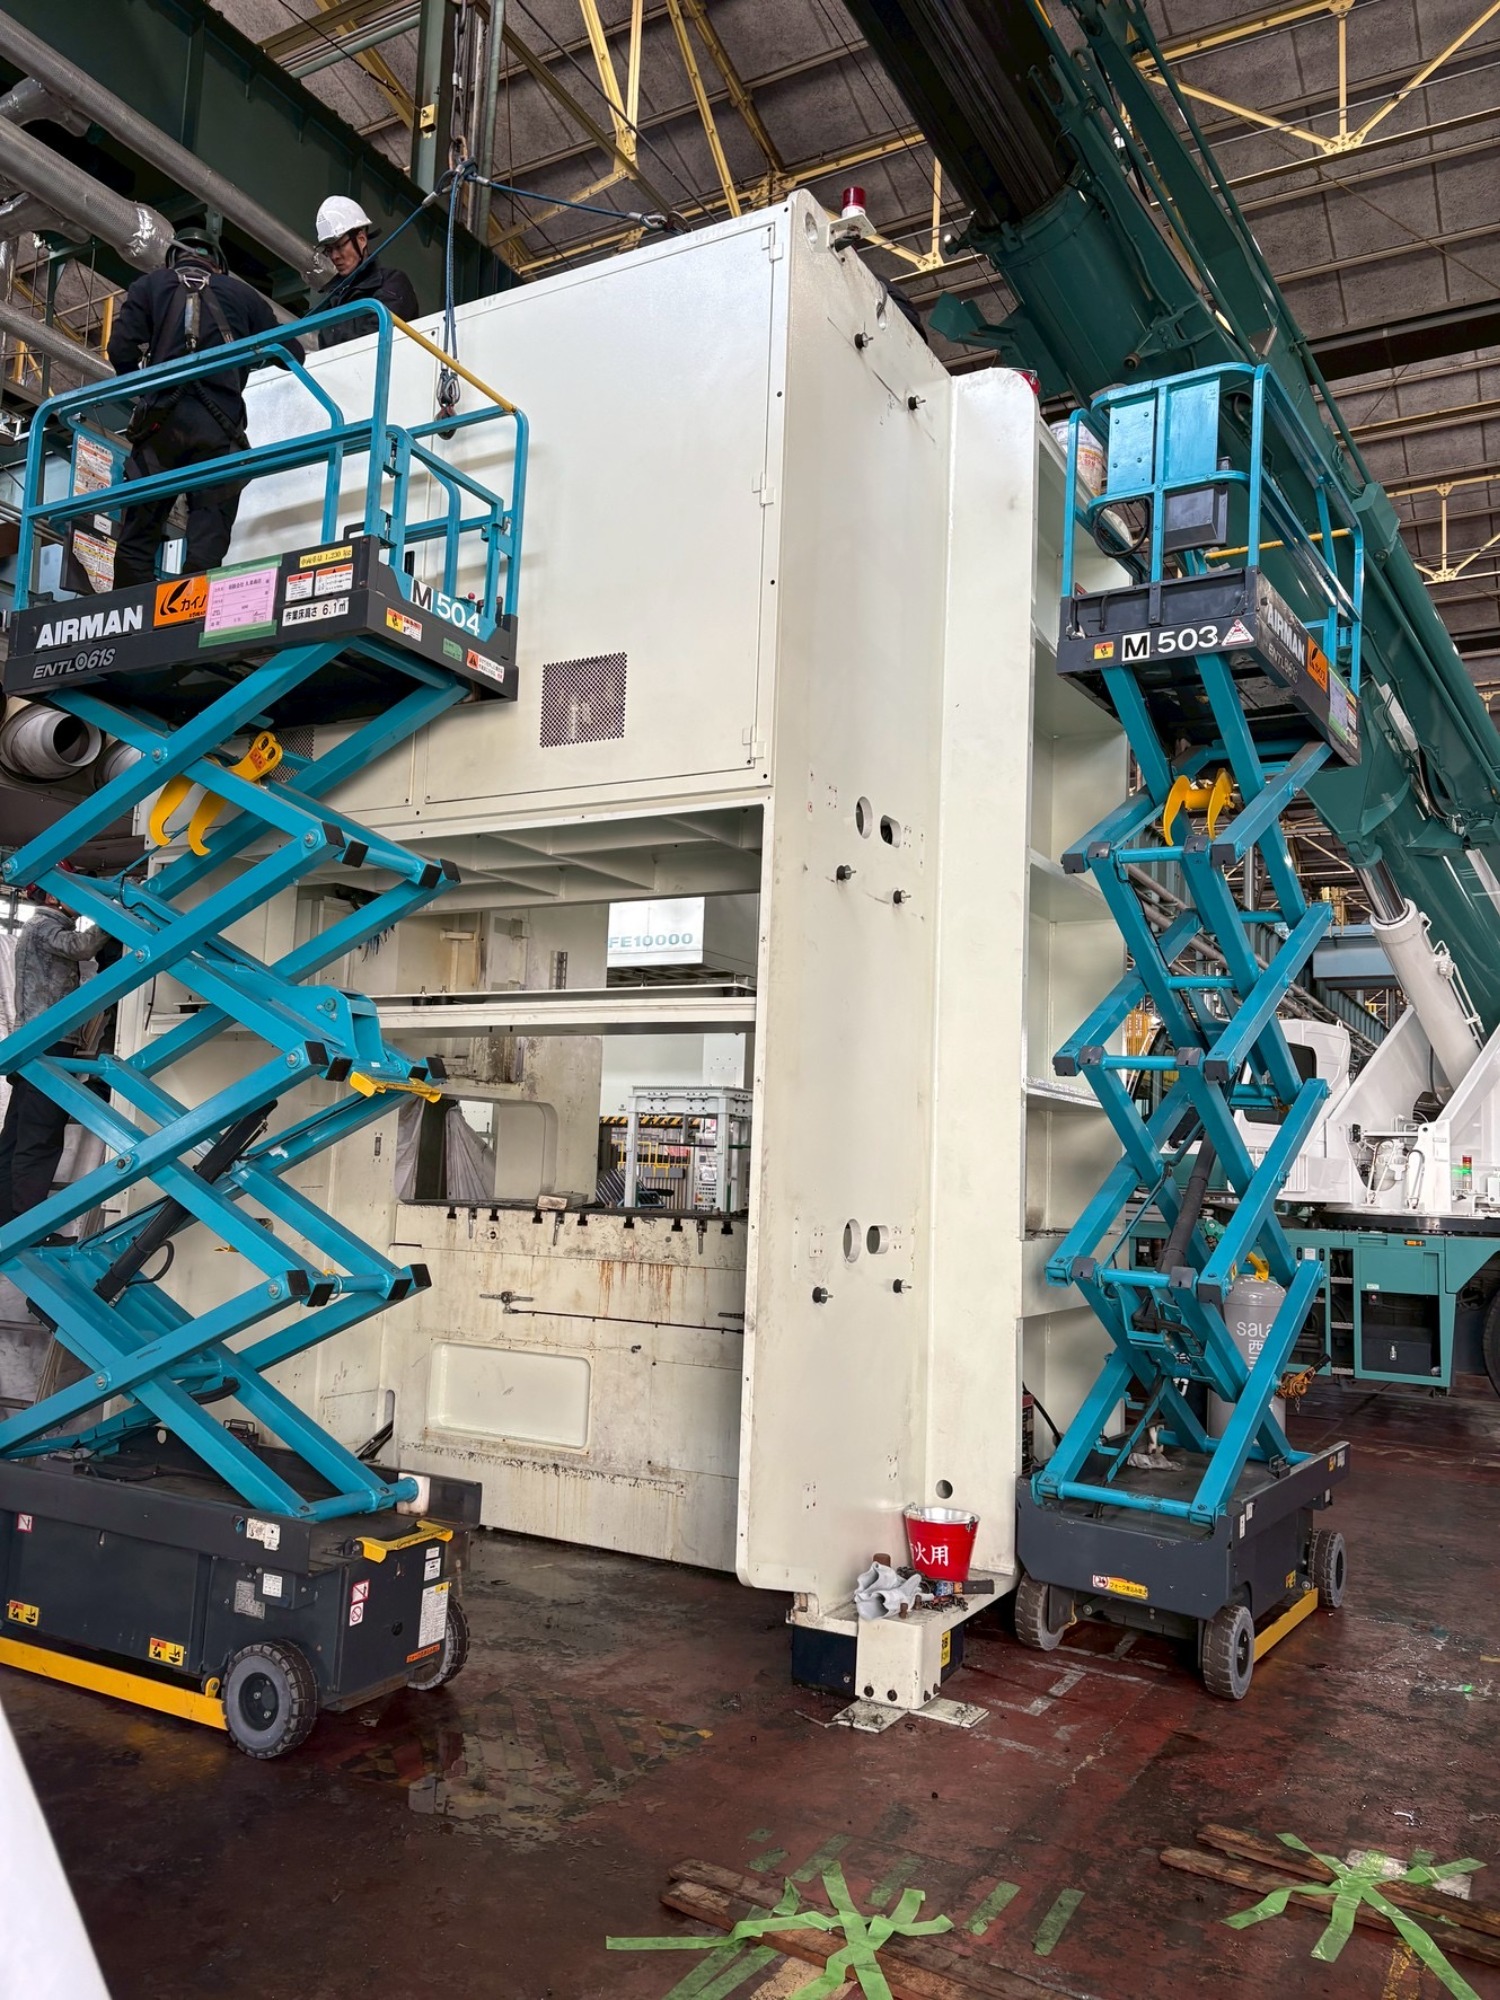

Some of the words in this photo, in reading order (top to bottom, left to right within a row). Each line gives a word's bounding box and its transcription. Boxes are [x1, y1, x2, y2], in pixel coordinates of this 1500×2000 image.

[286, 607, 318, 621] 作業床高さ
[412, 579, 432, 611] M
[436, 592, 480, 637] 504
[35, 605, 143, 649] AIRMAN
[1124, 635, 1148, 658] M
[1157, 625, 1218, 653] 503
[1267, 603, 1305, 667] AIRMAN
[608, 933, 693, 949] FE10000
[910, 1541, 949, 1567] 火用
